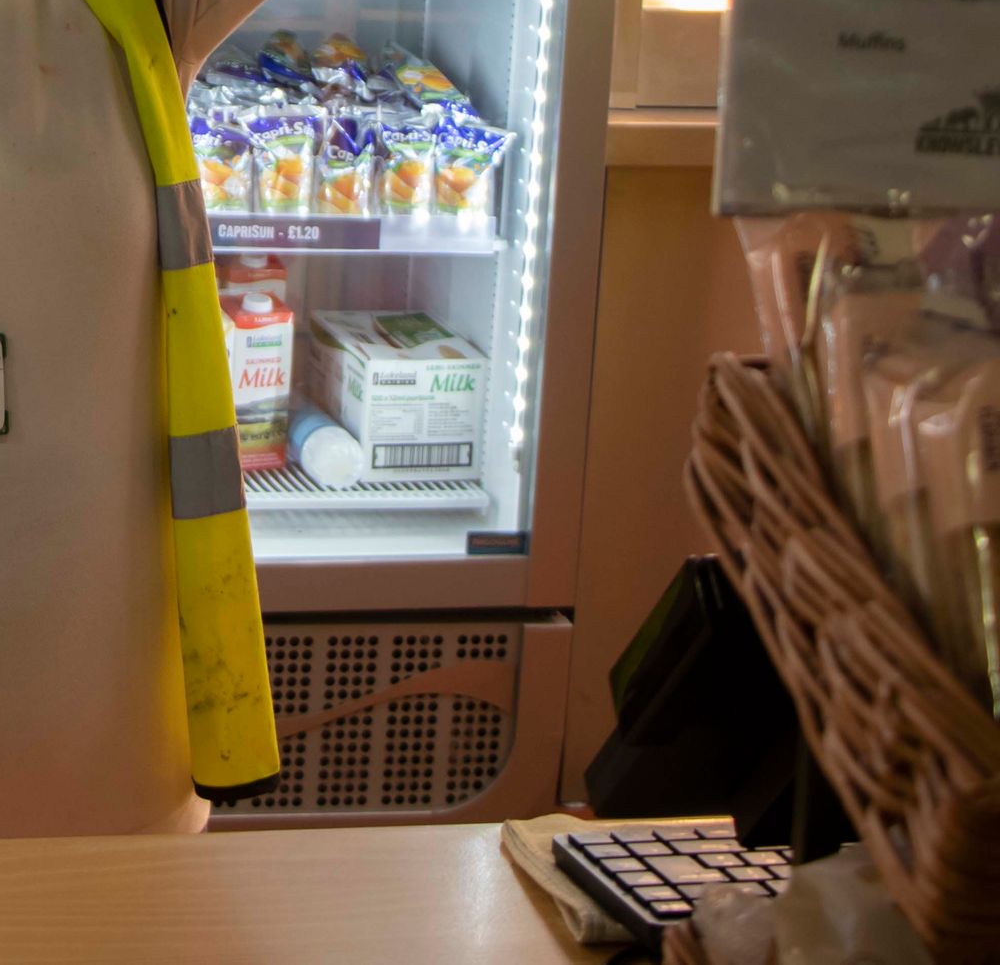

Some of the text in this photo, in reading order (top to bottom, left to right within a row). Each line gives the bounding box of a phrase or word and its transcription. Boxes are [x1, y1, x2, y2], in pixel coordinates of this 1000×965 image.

[838, 31, 906, 52] Muffins
[287, 225, 321, 240] £1.20
[238, 366, 286, 390] Milk
[429, 373, 476, 393] Milk
